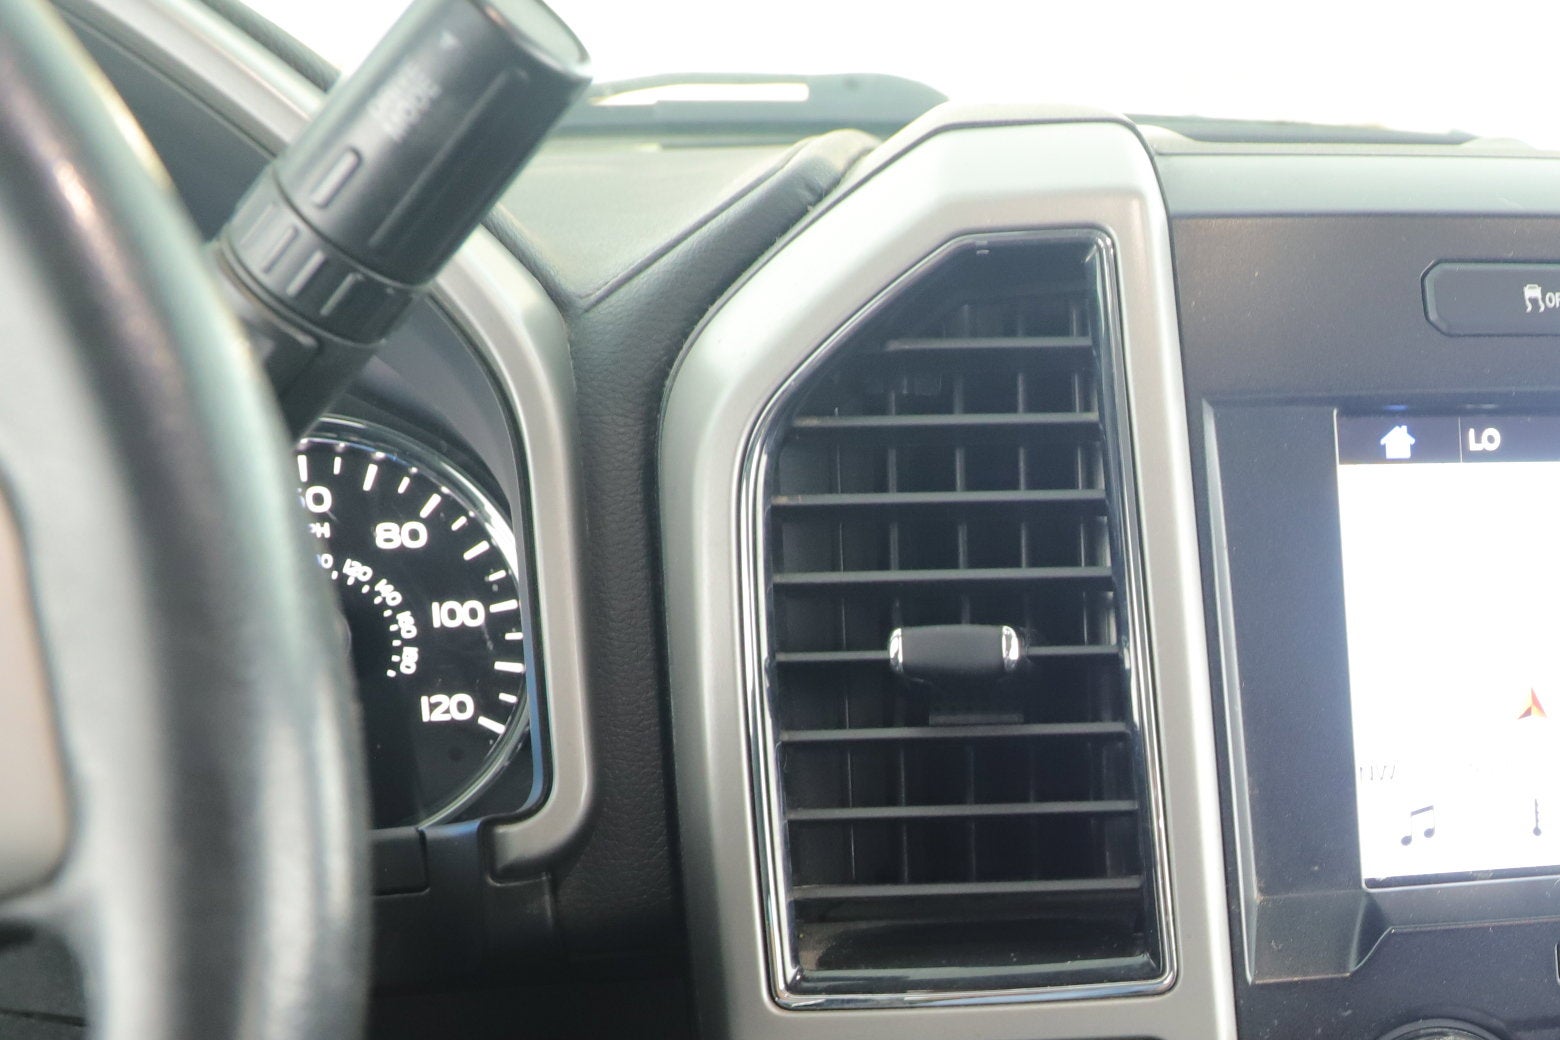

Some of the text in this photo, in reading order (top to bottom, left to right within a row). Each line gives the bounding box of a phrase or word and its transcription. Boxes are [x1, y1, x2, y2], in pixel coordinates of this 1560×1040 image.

[1469, 428, 1501, 451] LO
[300, 485, 333, 513] 0
[375, 522, 428, 549] 80
[342, 558, 373, 582] 120
[375, 579, 402, 606] 140
[432, 600, 485, 628] 100
[421, 693, 474, 722] 120
